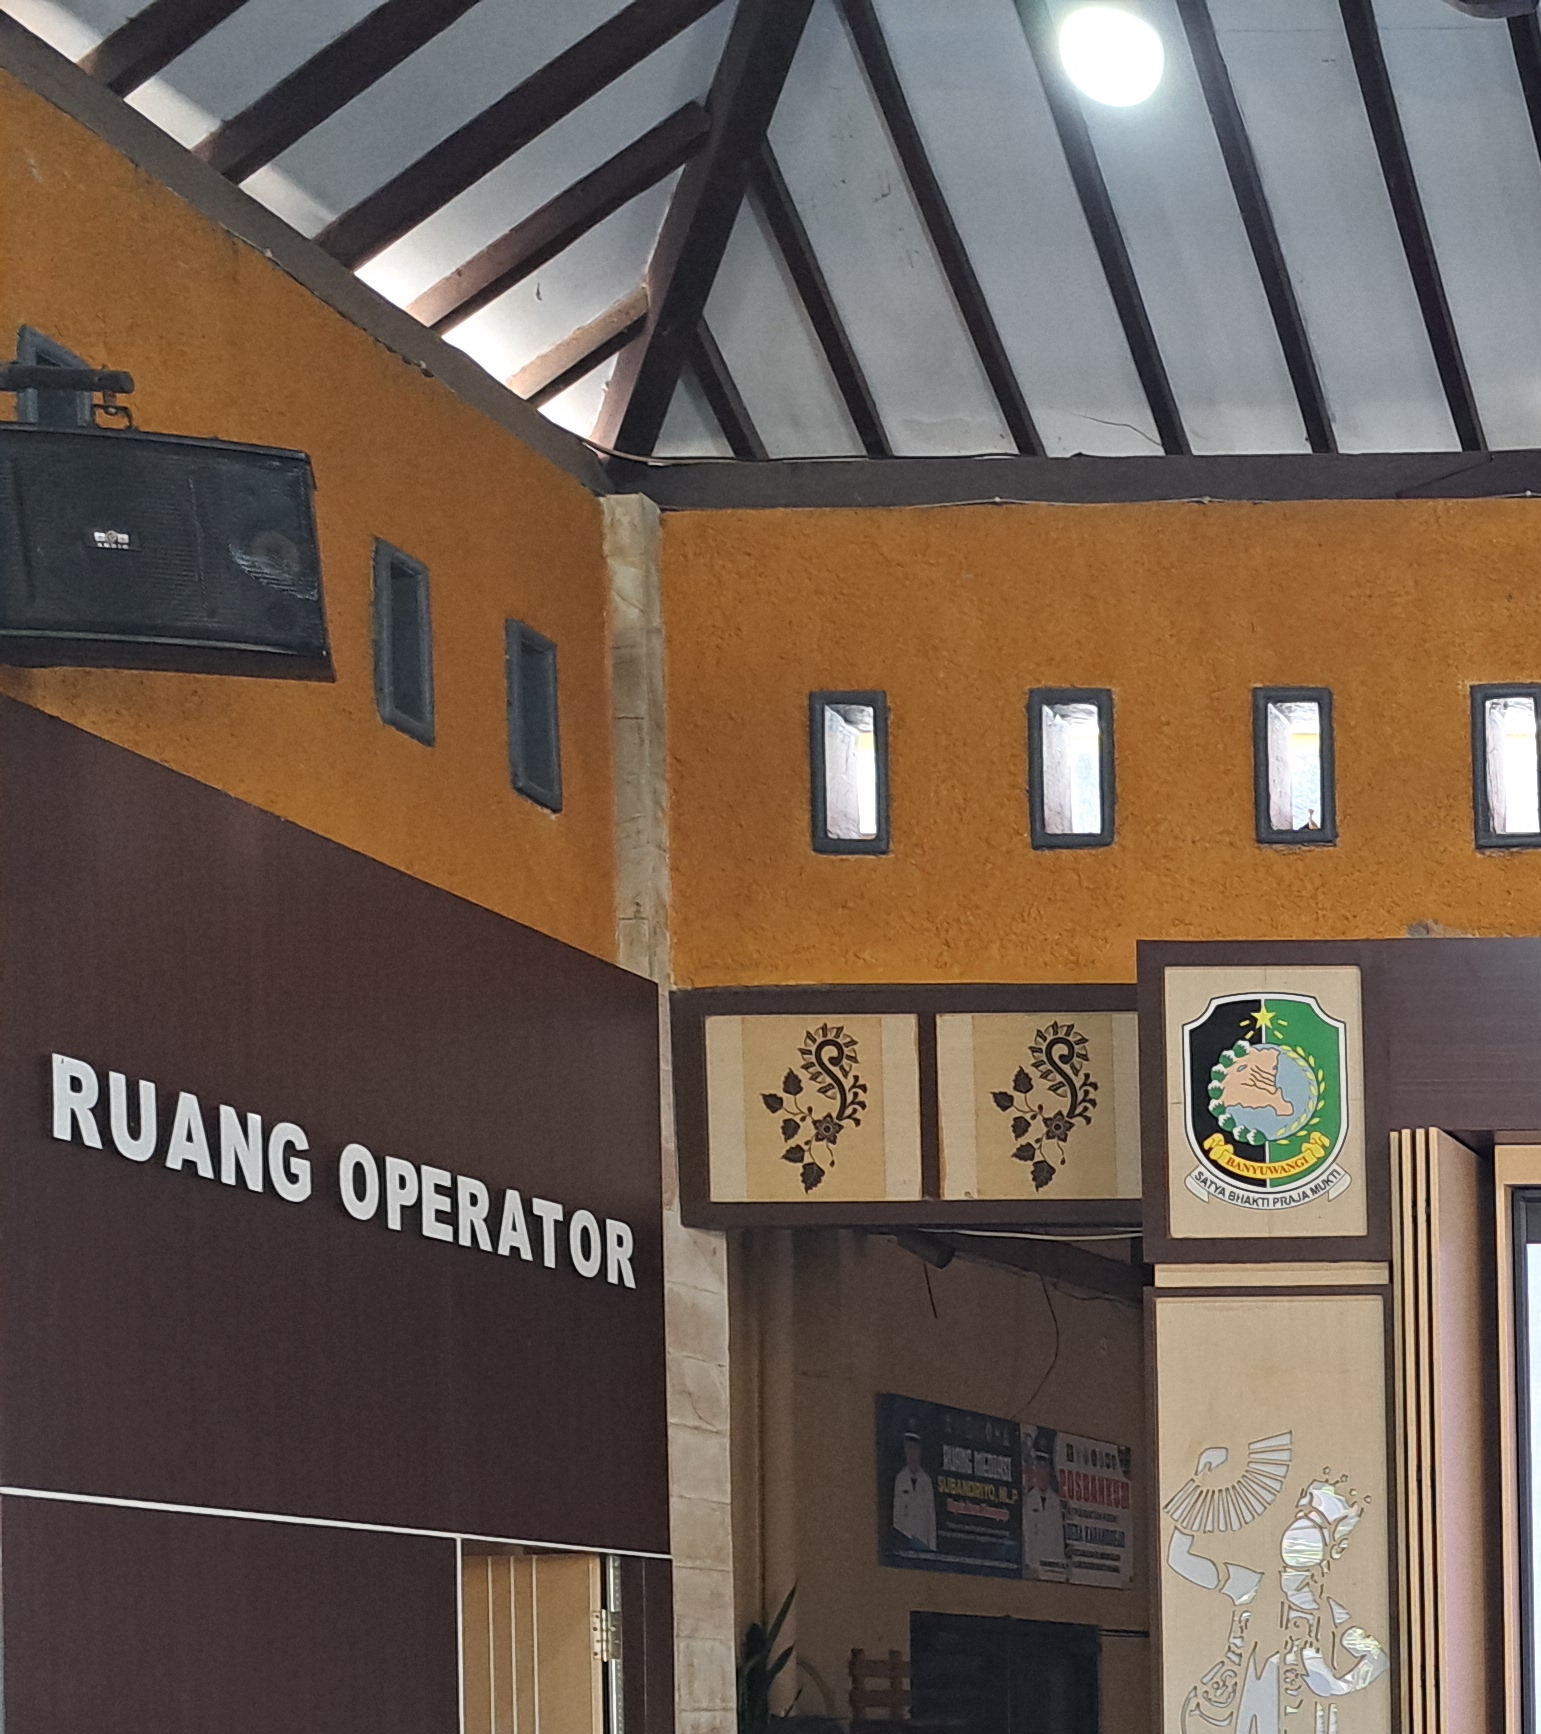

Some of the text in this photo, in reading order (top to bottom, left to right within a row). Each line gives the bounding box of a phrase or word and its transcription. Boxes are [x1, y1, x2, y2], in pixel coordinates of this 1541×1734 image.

[50, 1052, 638, 1290] RUANG OPERATOR
[1226, 1157, 1309, 1176] BANYUWANGI
[1195, 1170, 1343, 1207] SATYA BHAKTI PRAJA MUKTI
